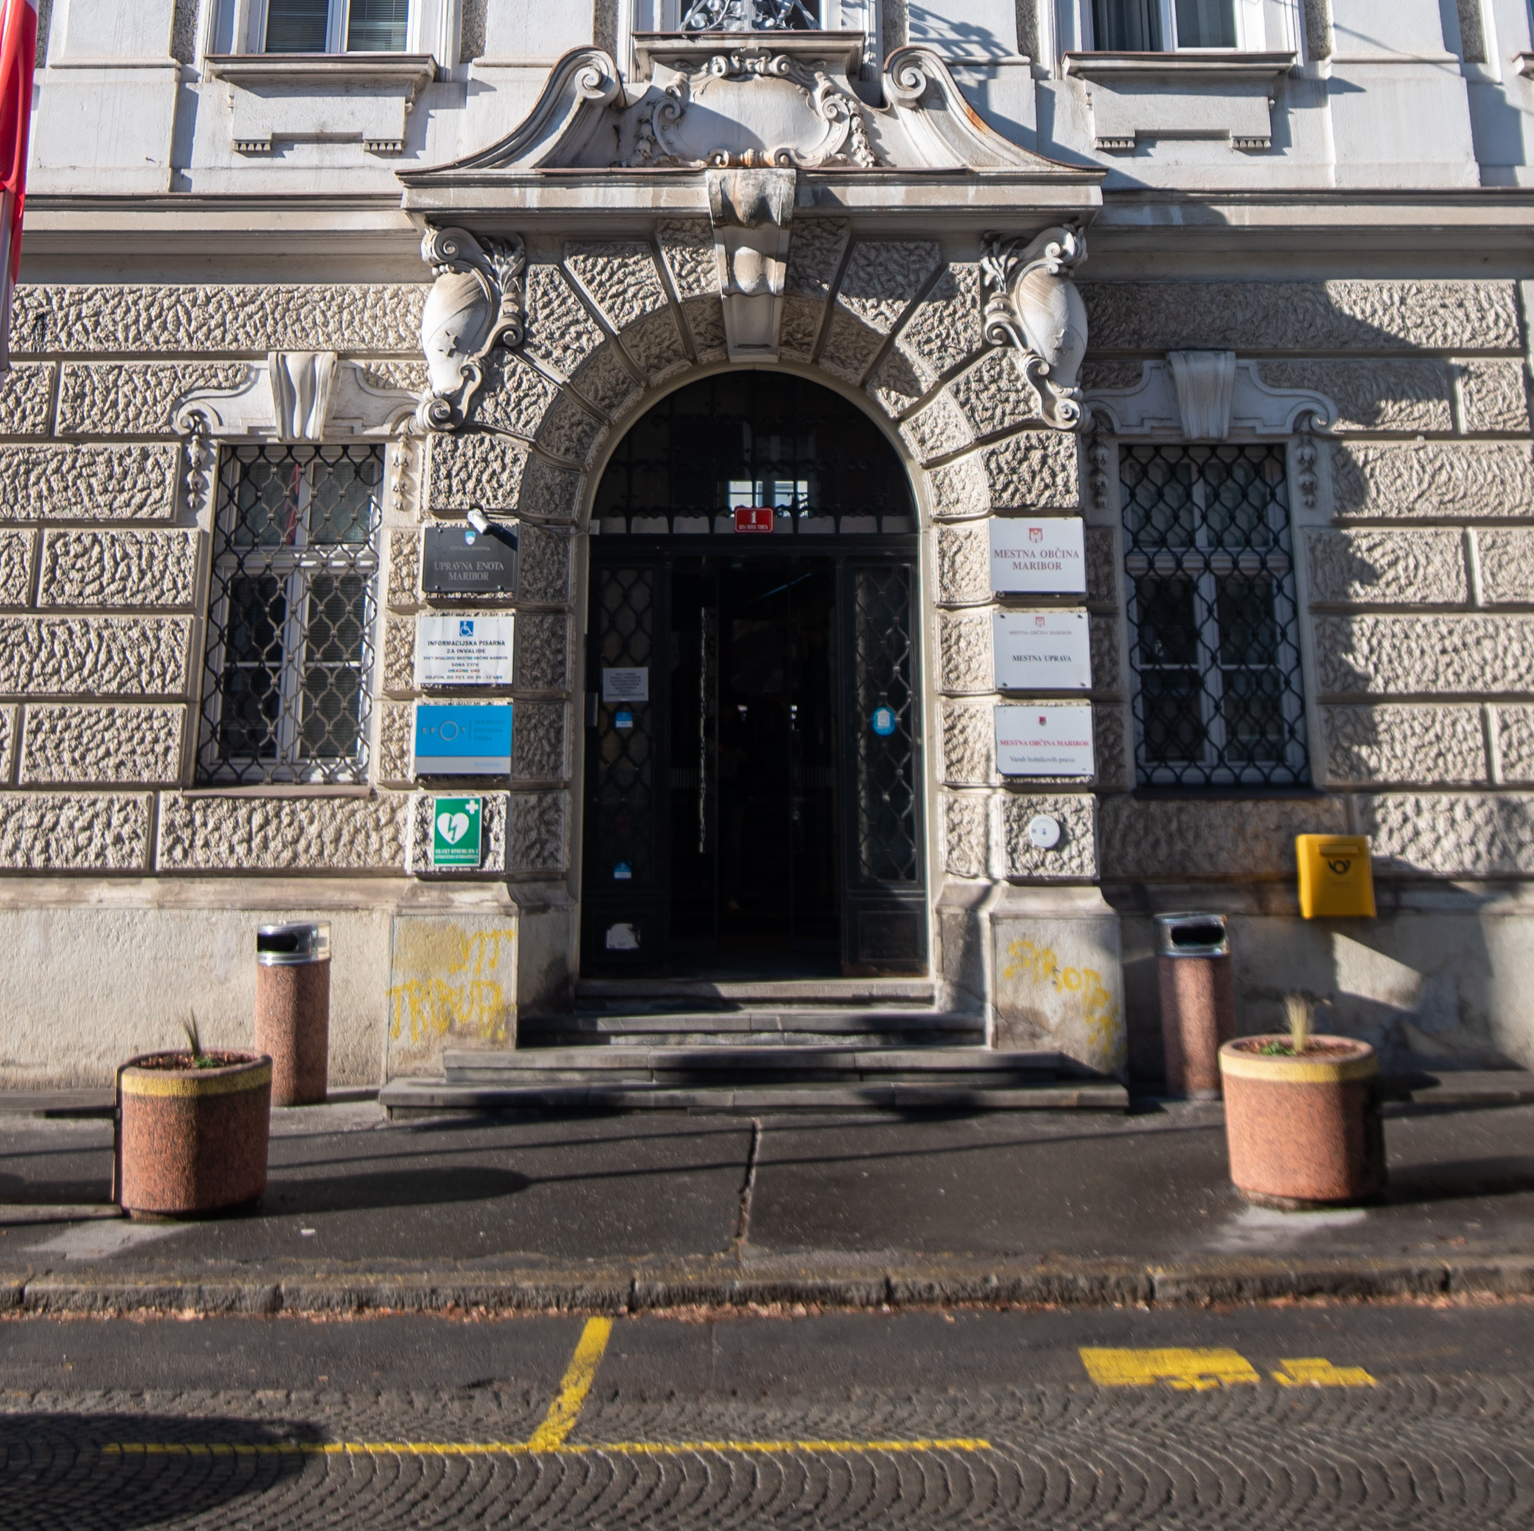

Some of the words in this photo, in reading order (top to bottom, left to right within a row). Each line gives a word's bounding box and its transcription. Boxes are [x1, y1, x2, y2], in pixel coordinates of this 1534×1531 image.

[751, 510, 757, 524] 1
[994, 549, 1037, 559] MESTNA
[1040, 547, 1079, 559] OBČINA
[434, 561, 473, 571] UPRAVNA
[476, 561, 505, 571] ENOTA
[1013, 561, 1062, 570] MARIBOR
[448, 571, 489, 580] MARIBOR
[1029, 738, 1055, 746] OBČINA
[1057, 739, 1090, 747] MARIBOR
